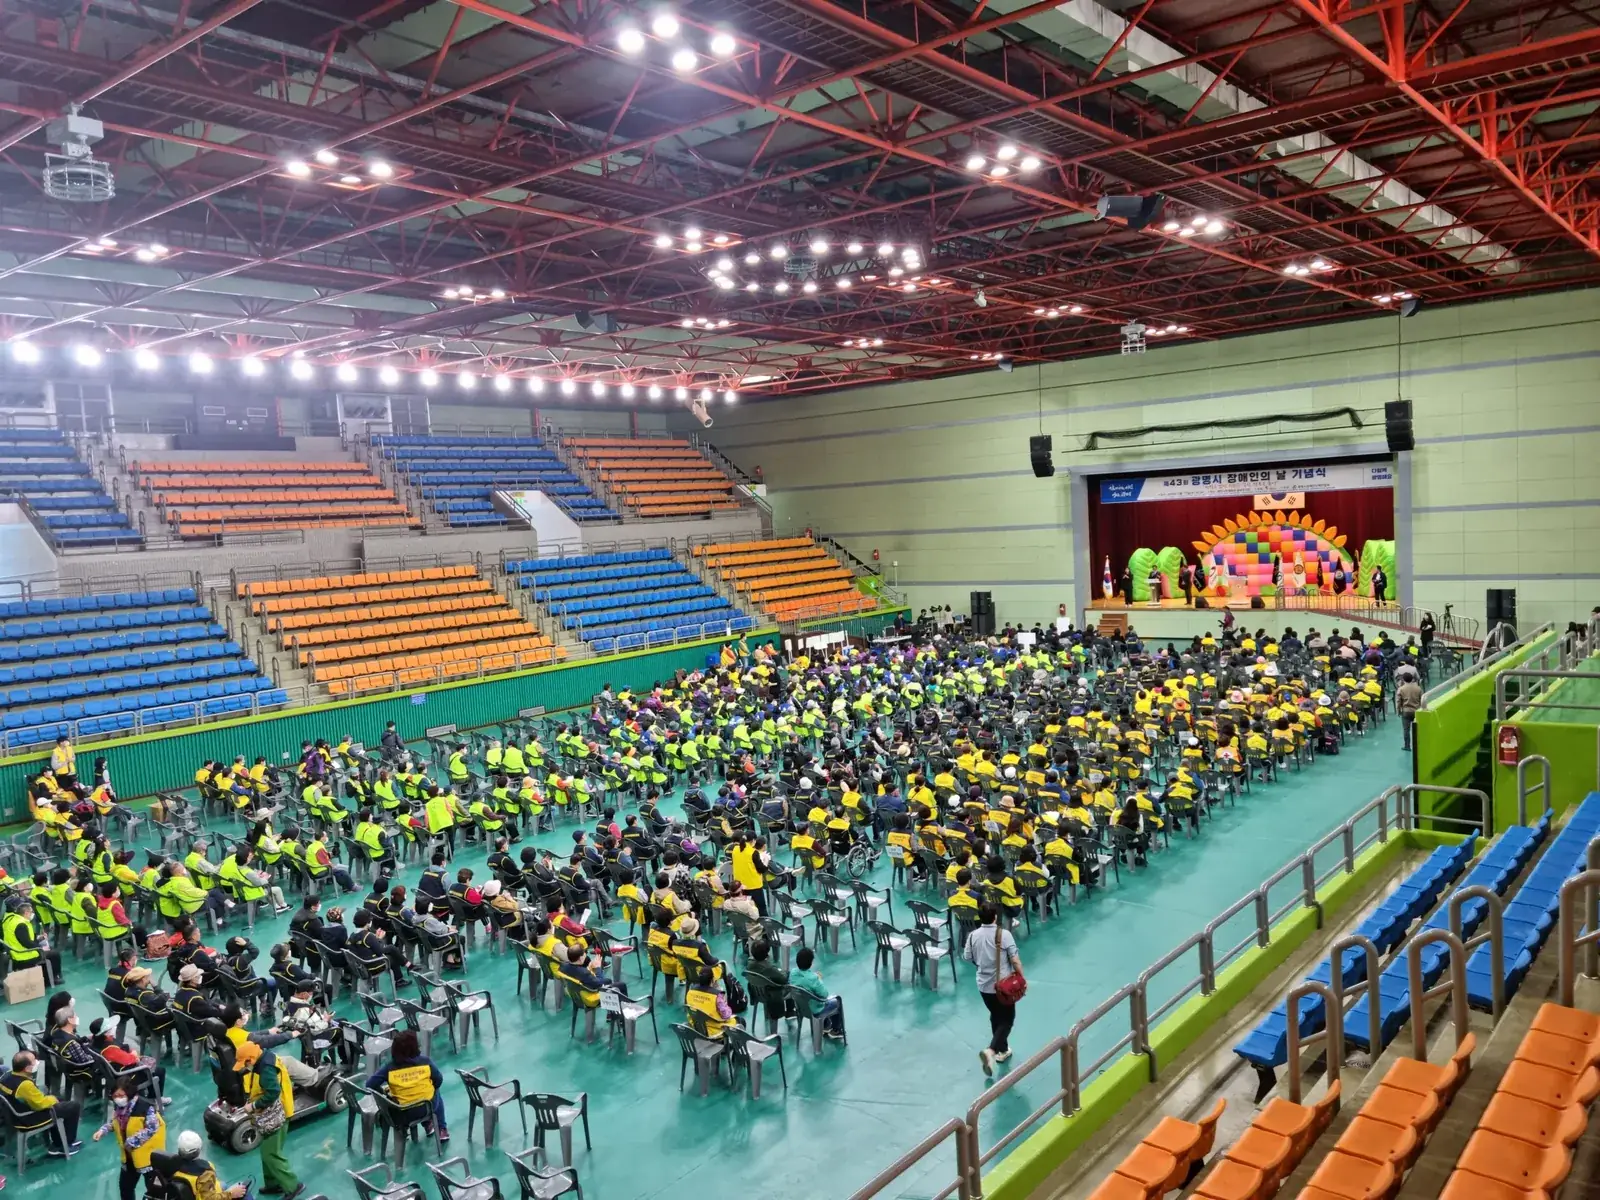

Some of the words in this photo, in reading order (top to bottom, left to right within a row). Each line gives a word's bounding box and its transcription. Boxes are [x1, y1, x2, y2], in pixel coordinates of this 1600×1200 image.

[1191, 475, 1222, 486] 광명시
[1227, 471, 1270, 483] 장애인의
[1276, 470, 1286, 481] 날
[1292, 467, 1326, 479] 기념식
